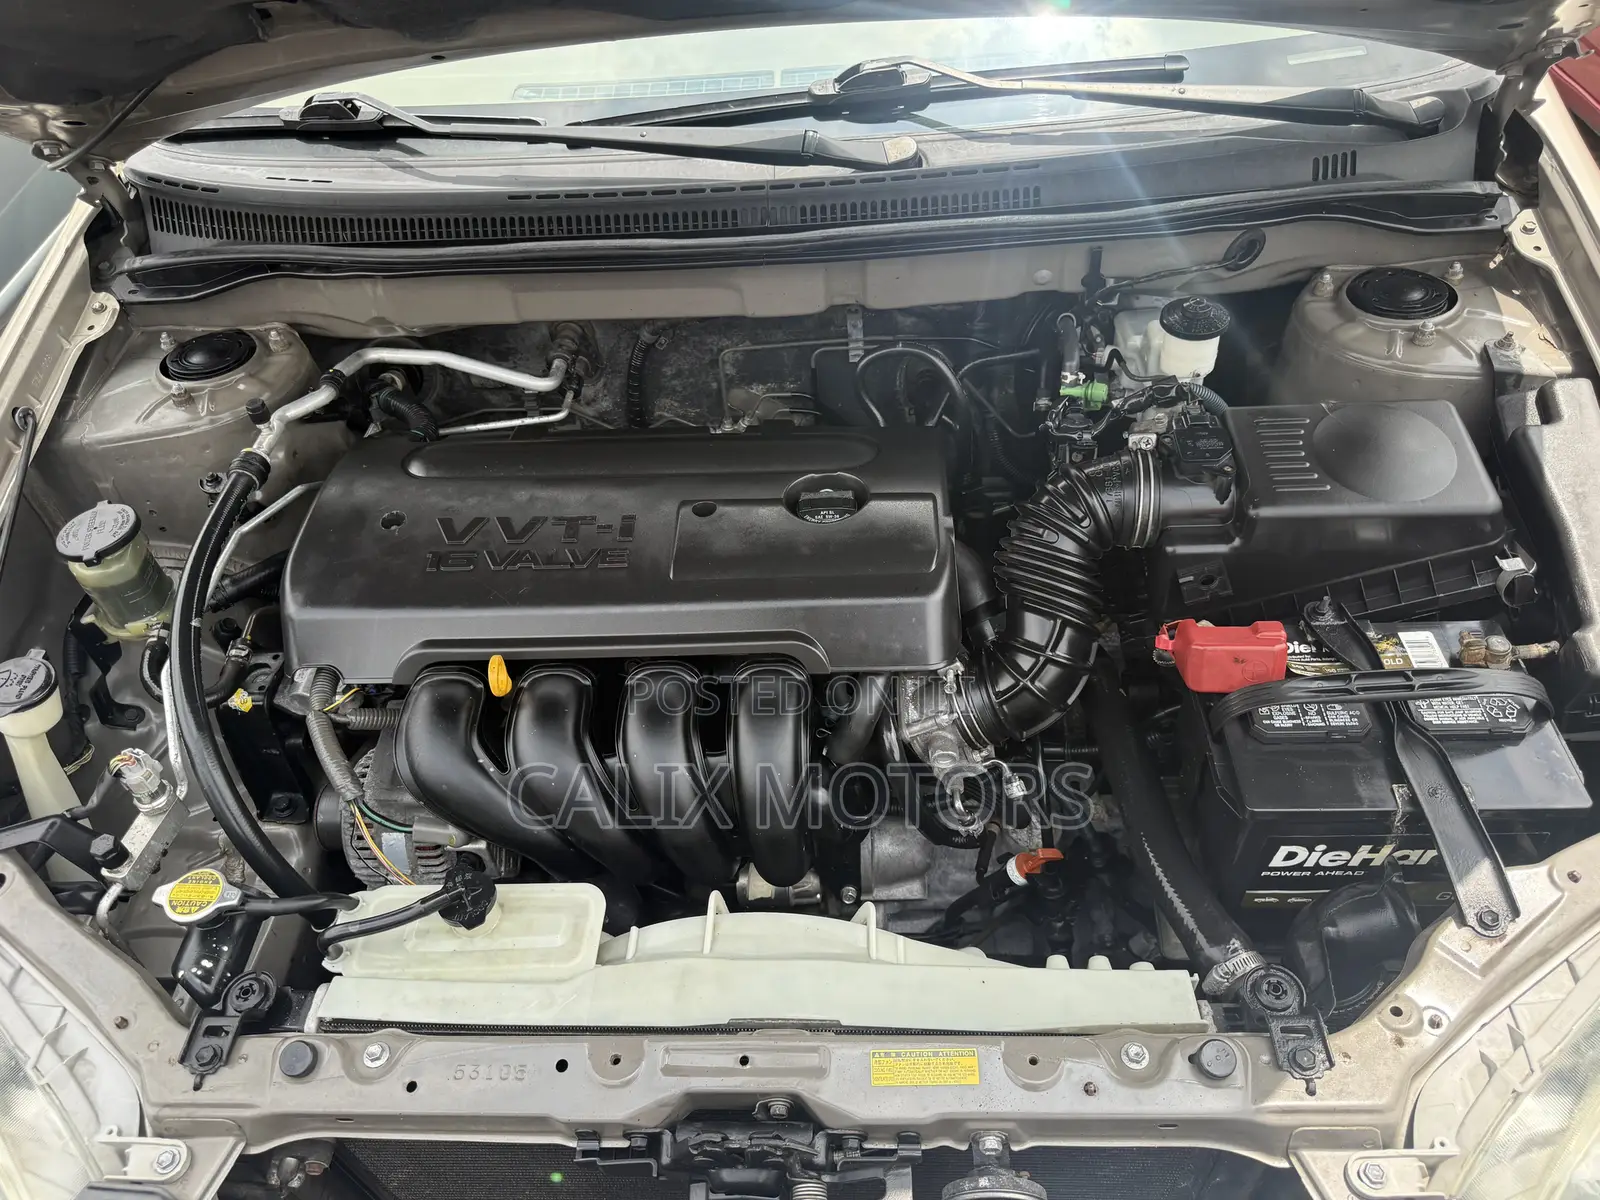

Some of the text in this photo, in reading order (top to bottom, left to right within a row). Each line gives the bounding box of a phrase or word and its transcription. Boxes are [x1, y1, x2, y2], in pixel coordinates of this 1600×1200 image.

[426, 548, 630, 571] 16 VALVE
[1268, 844, 1438, 868] DieHar
[938, 1049, 975, 1057] ATTENTION
